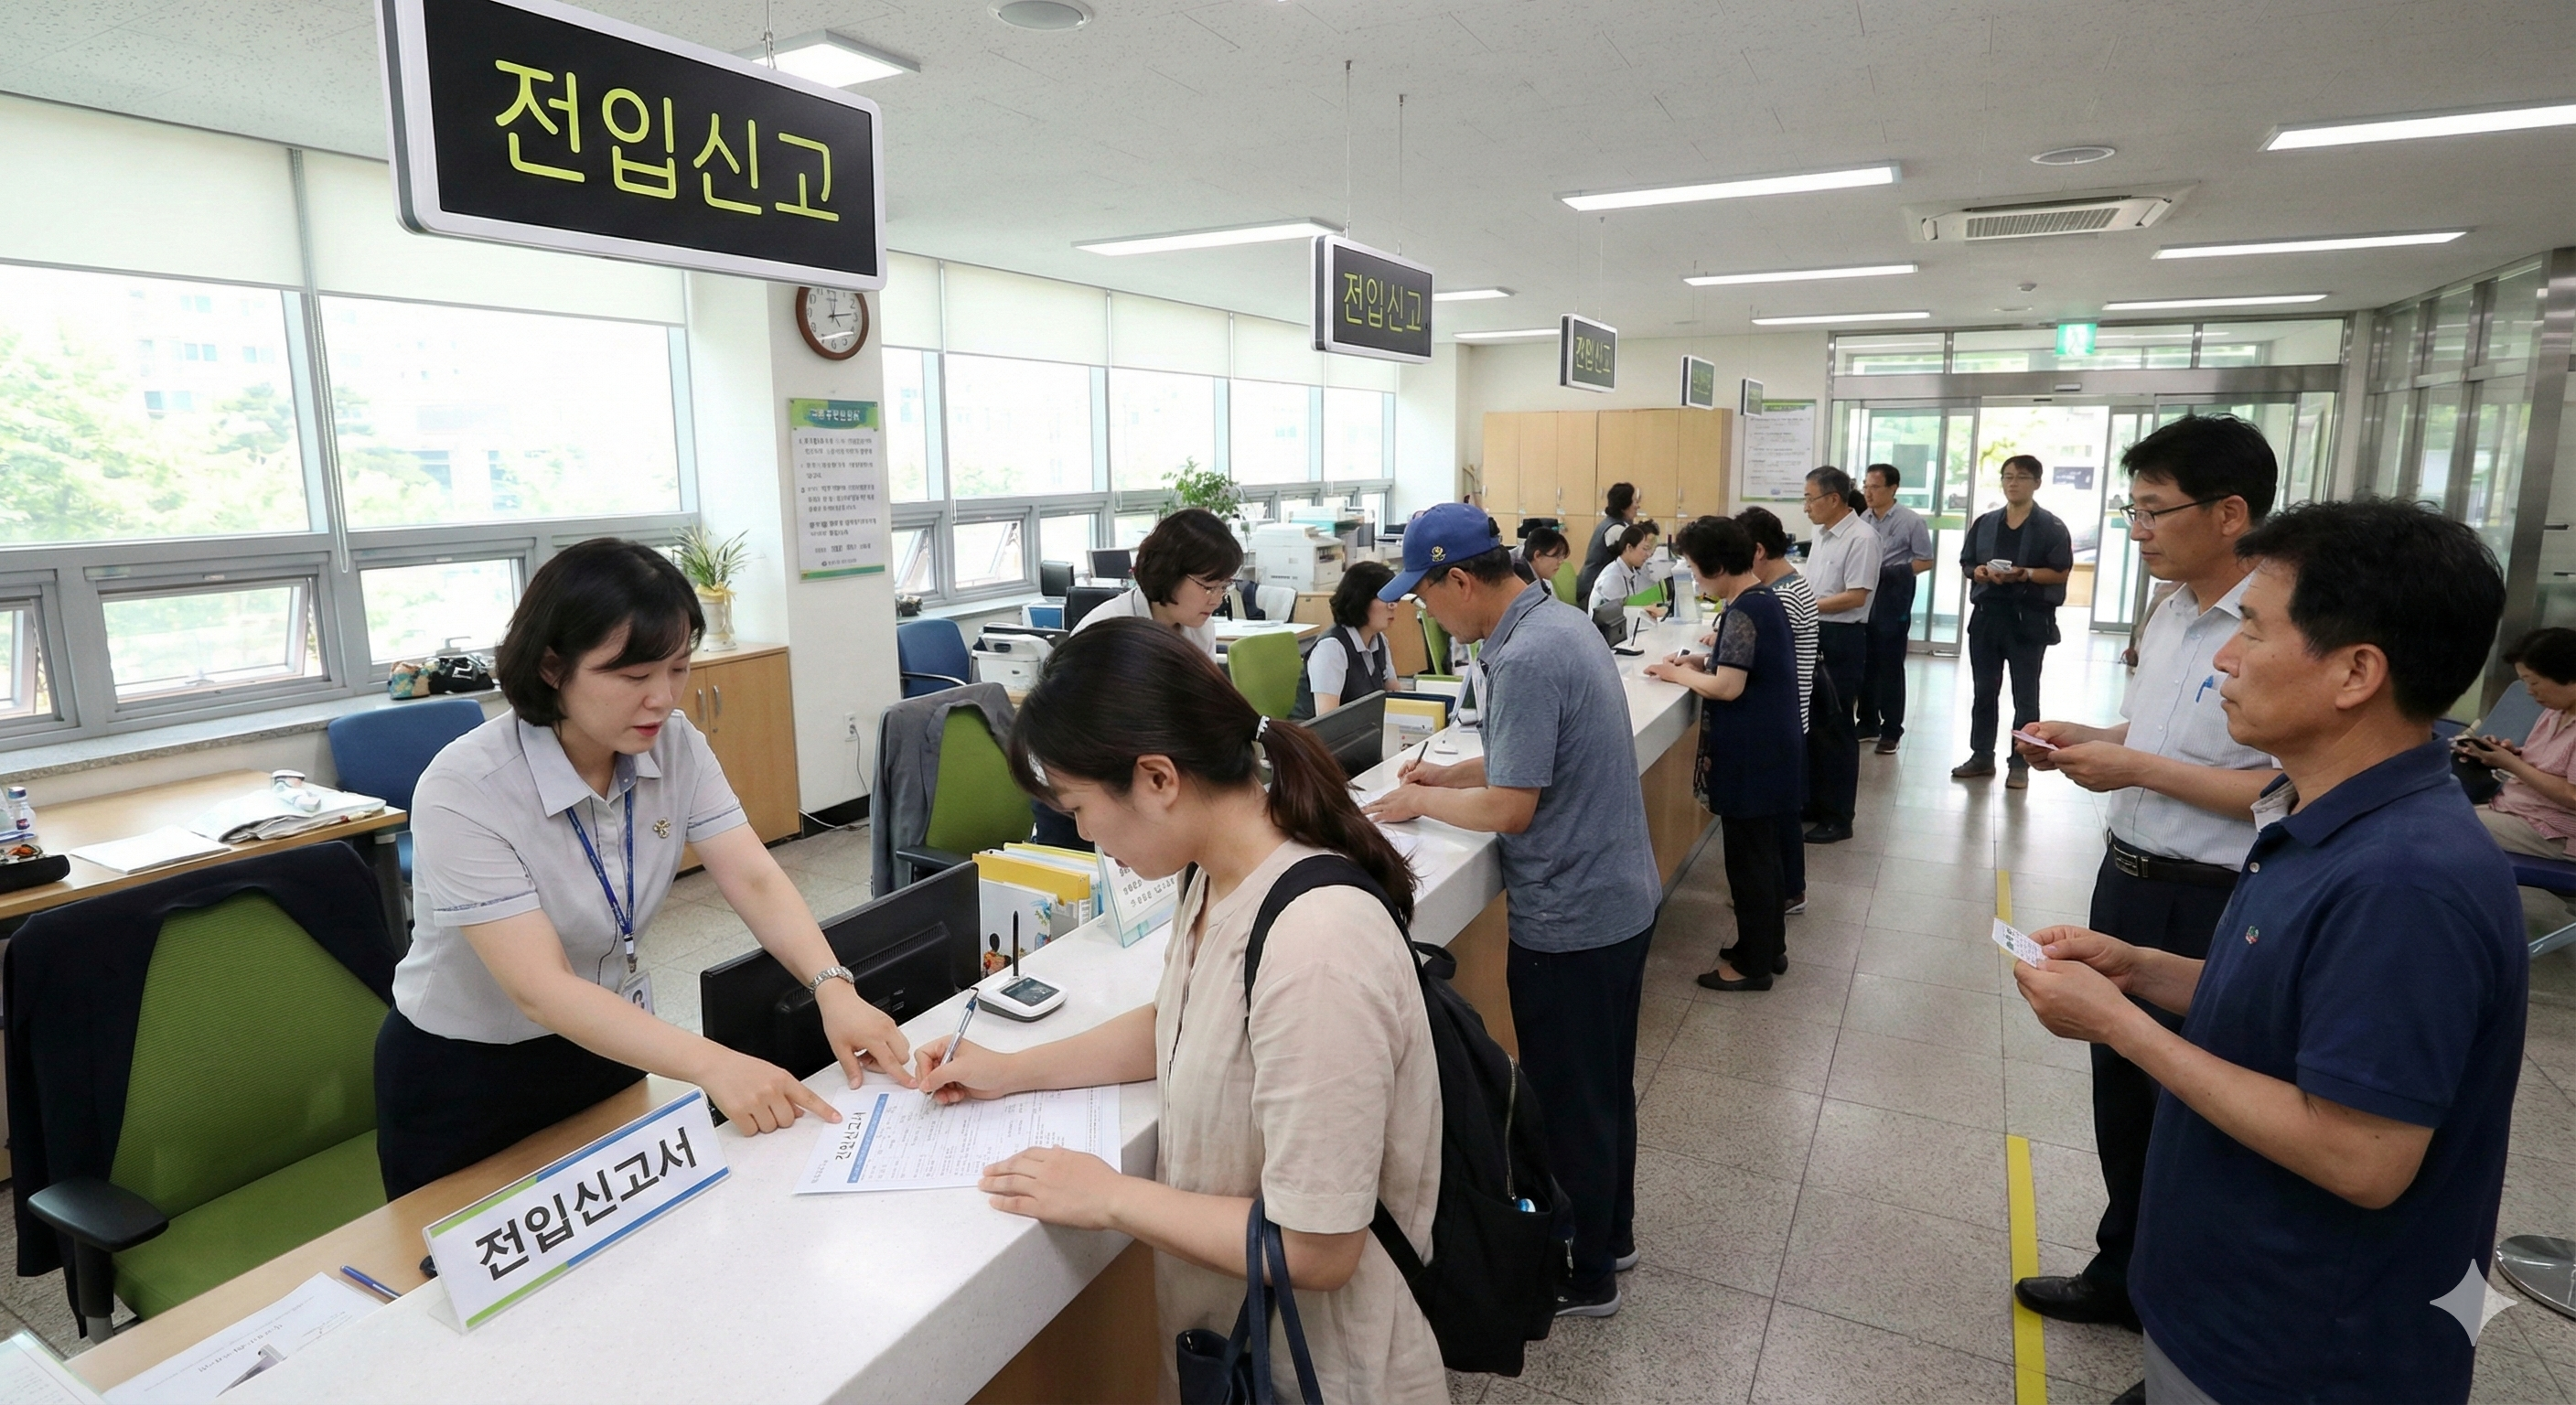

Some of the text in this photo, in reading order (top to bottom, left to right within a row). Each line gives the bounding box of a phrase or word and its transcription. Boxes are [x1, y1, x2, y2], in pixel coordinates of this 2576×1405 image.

[495, 59, 839, 221] 전입신고
[1344, 273, 1422, 332] 전입신고
[475, 1127, 697, 1281] 전입신고서
